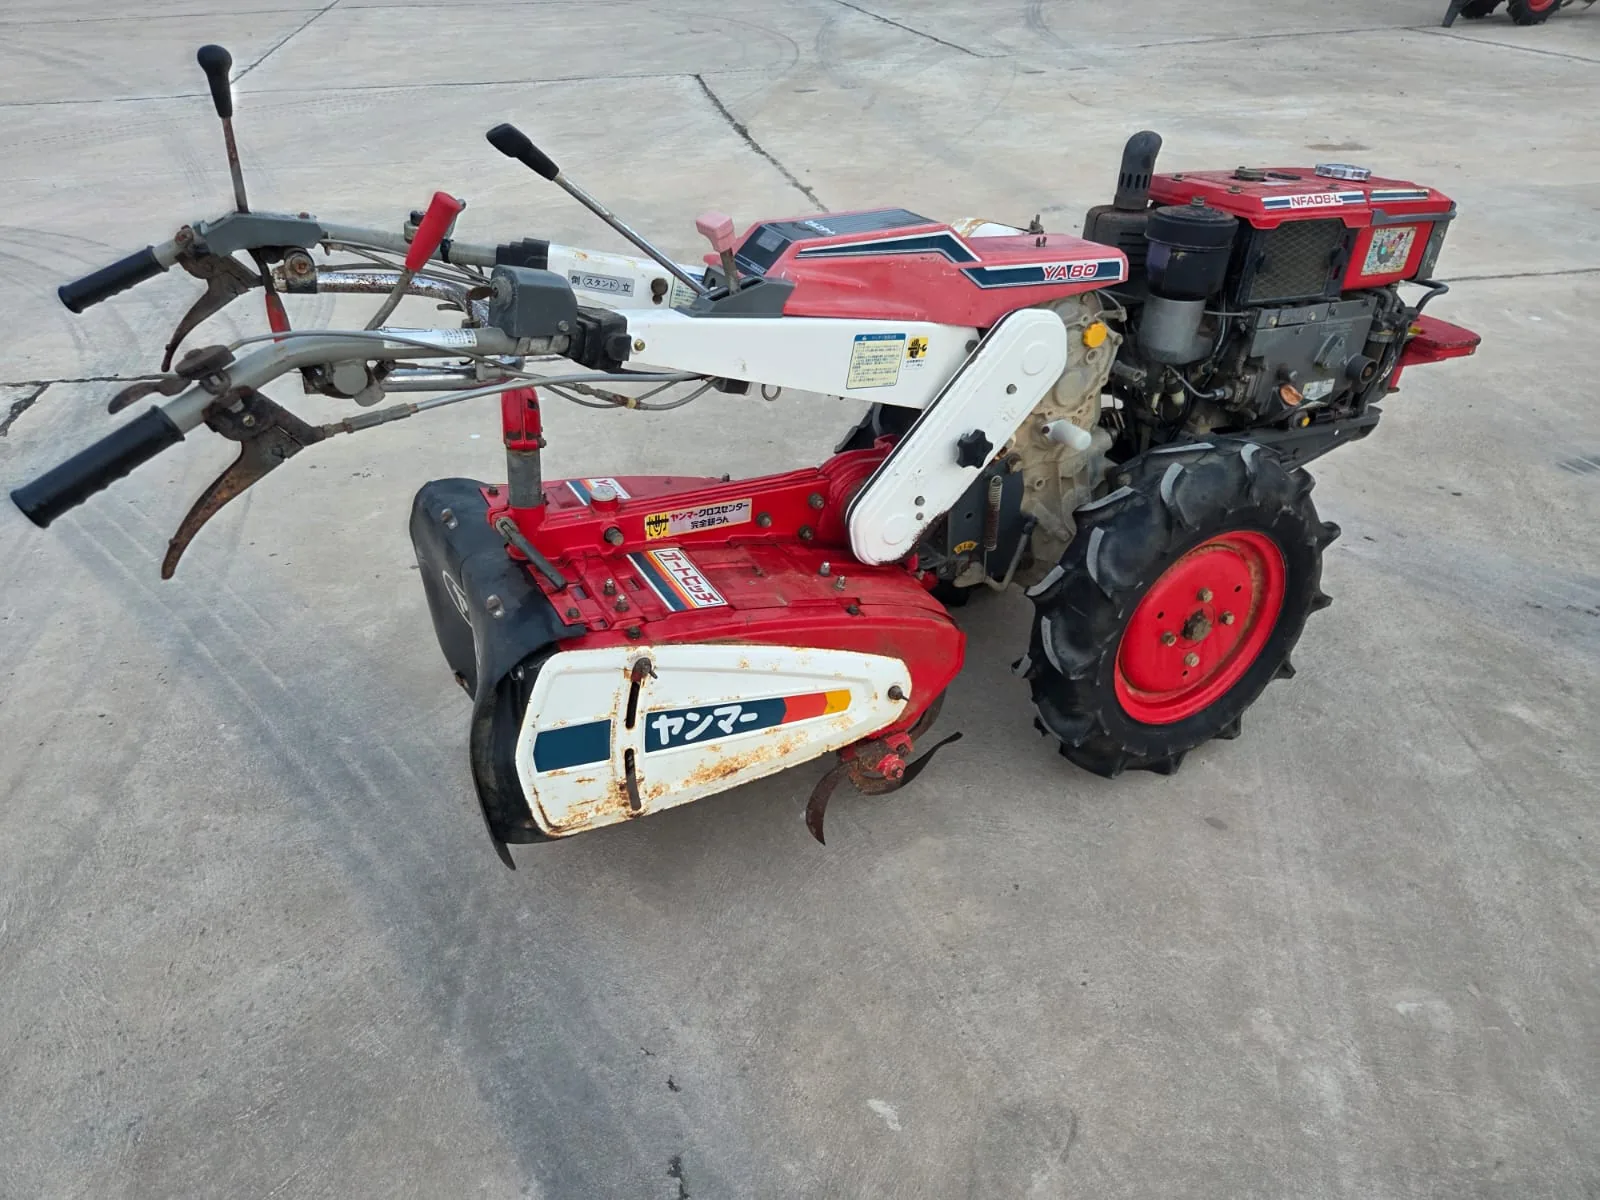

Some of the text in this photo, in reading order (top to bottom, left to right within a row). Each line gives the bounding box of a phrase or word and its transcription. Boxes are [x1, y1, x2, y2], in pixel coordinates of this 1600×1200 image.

[586, 278, 616, 289] スタンド
[621, 283, 631, 292] 立
[659, 552, 719, 603] オートヒッチ
[652, 705, 758, 745] ヤンマー
